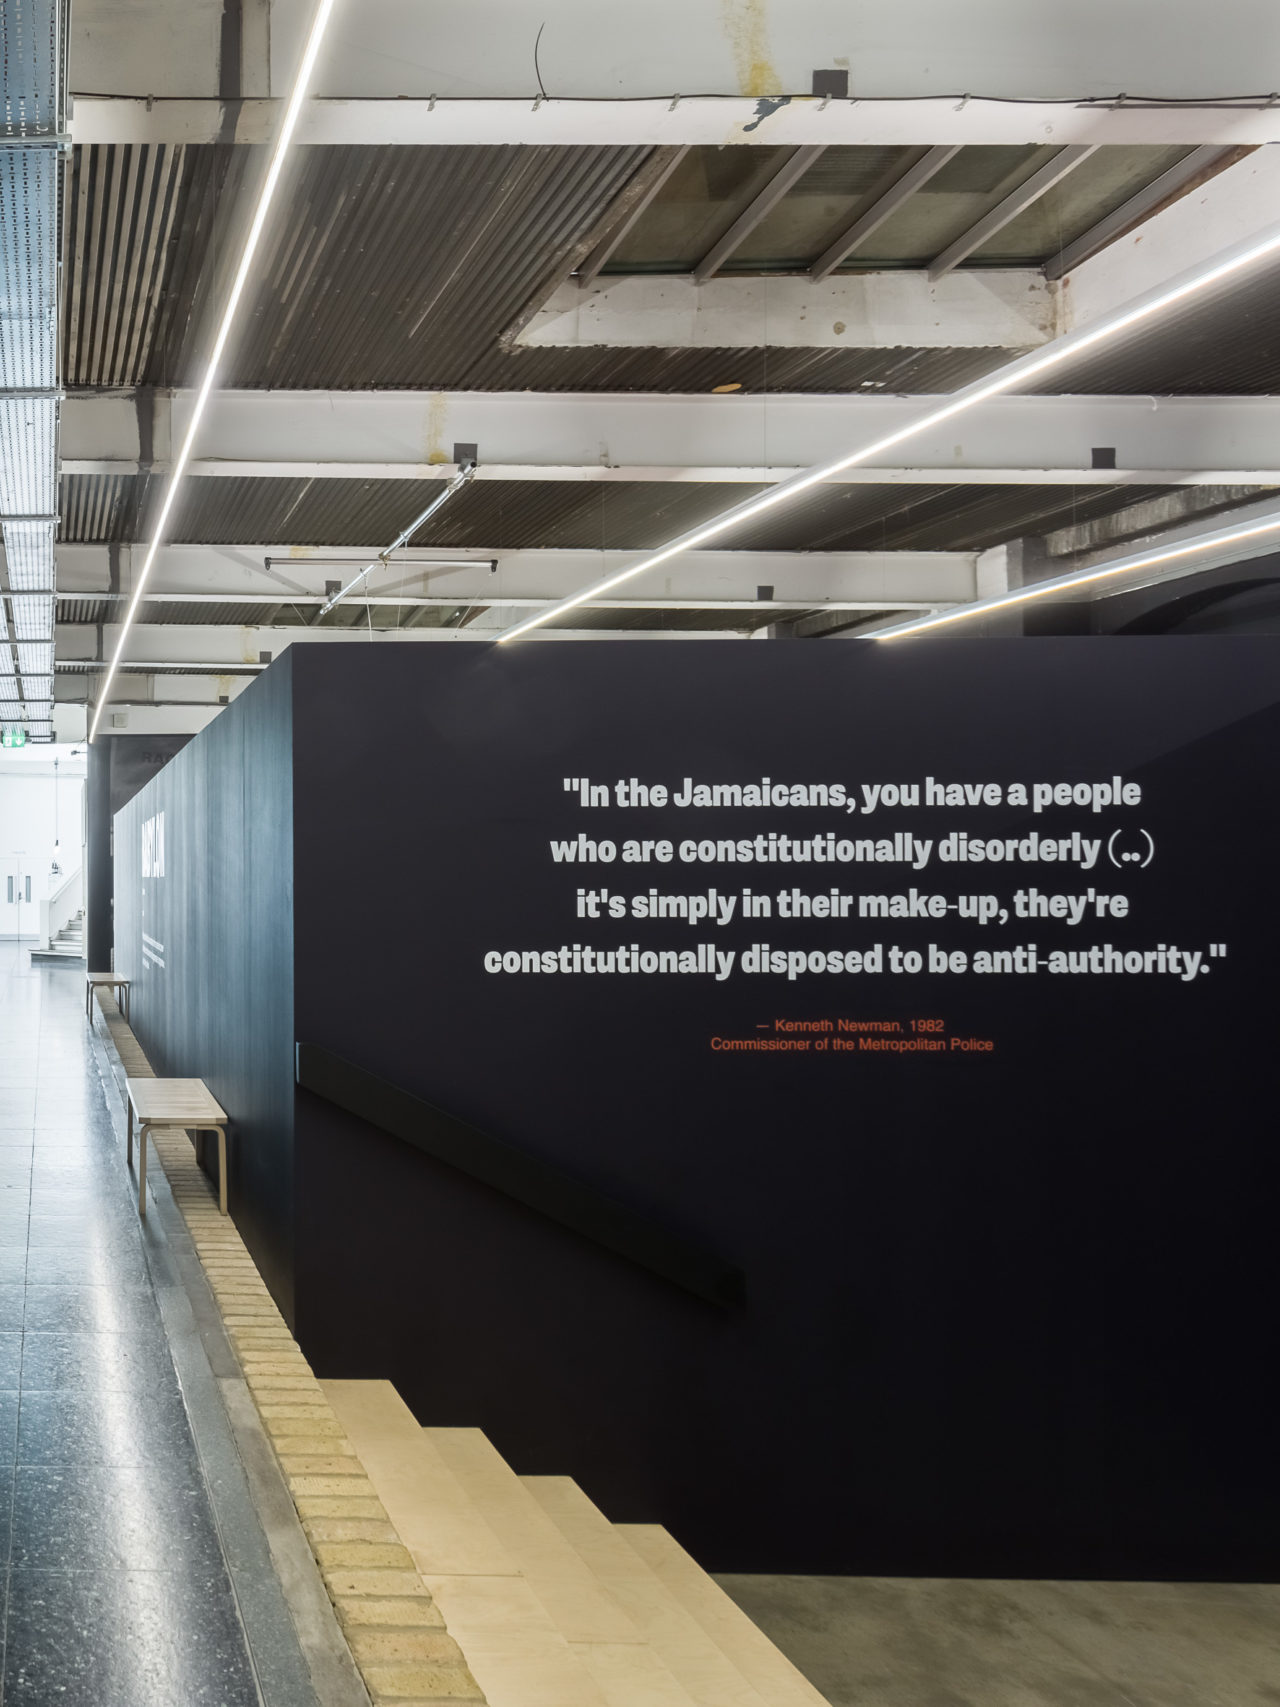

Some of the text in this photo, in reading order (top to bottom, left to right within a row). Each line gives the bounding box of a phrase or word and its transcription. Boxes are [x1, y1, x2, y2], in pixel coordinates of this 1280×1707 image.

[564, 776, 1142, 815] "In the Jamaicans, you have a people
[550, 832, 616, 862] who
[622, 839, 674, 862] are
[679, 831, 934, 869] constitutionally
[939, 831, 1102, 869] disorderly
[577, 887, 1129, 925] it's simply in their make-up, they're
[484, 943, 1227, 982] constitutionally disposed to be anti-authority."
[711, 1037, 994, 1052] Commissioner of the Metropolitan Police
[775, 1019, 833, 1032] Kenneth
[838, 1019, 904, 1034] Newman,
[910, 1019, 945, 1032] 1982
